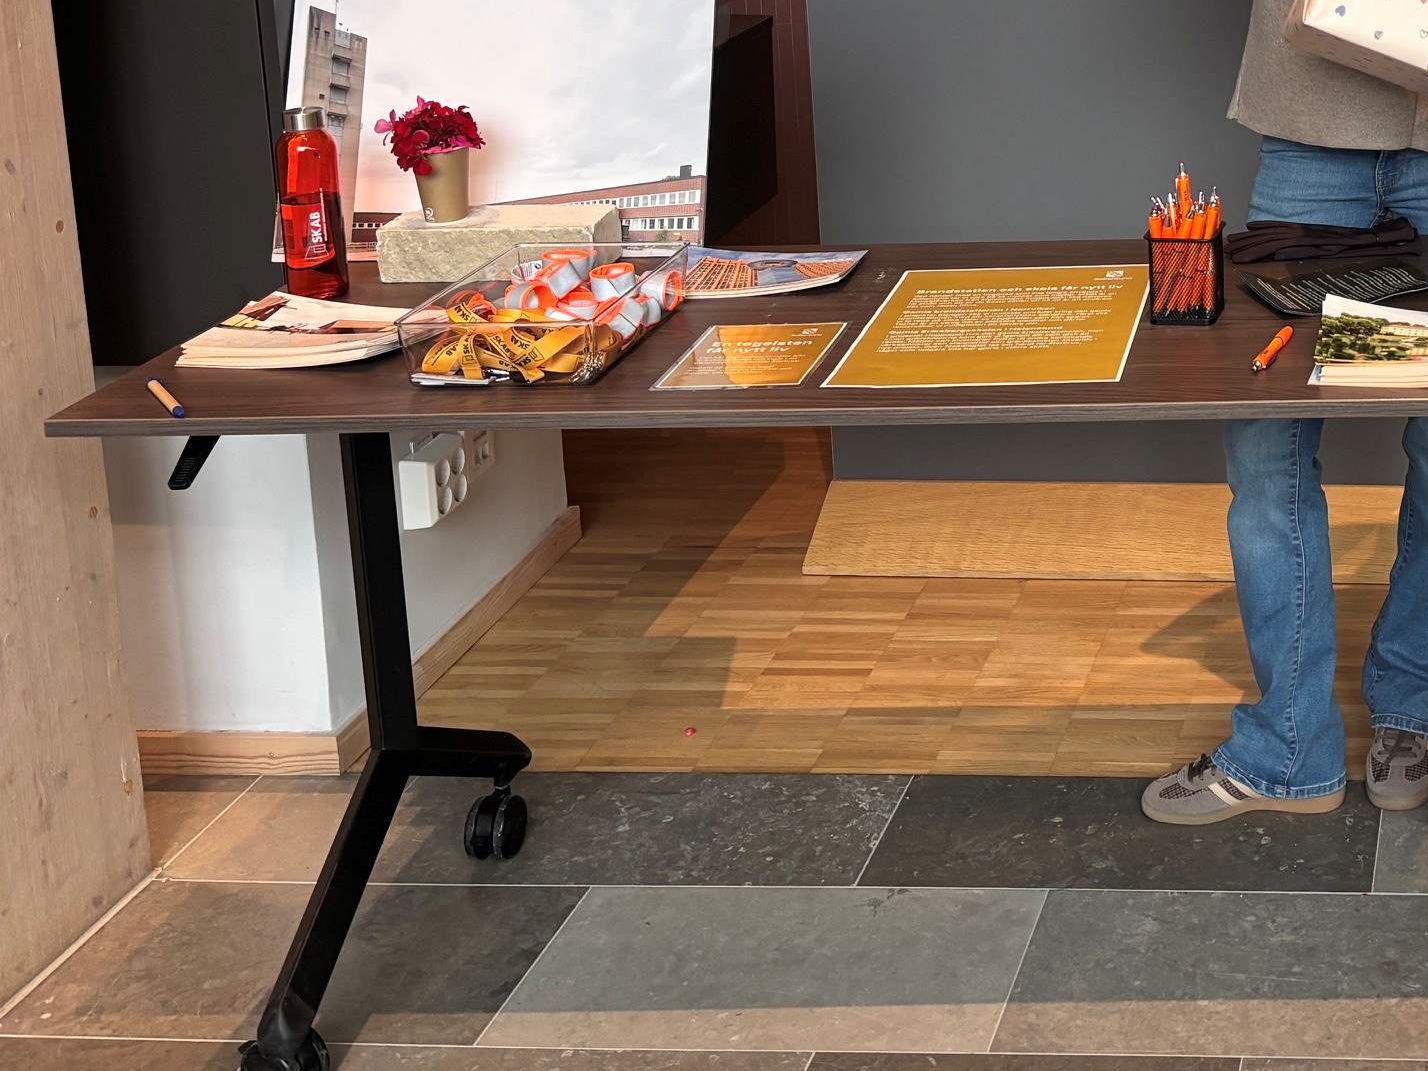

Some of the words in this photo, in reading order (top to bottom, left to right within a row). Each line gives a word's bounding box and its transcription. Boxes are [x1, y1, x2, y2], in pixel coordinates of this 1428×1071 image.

[309, 211, 323, 243] SKAB
[737, 340, 813, 348] tegelsten
[733, 346, 766, 354] nytt
